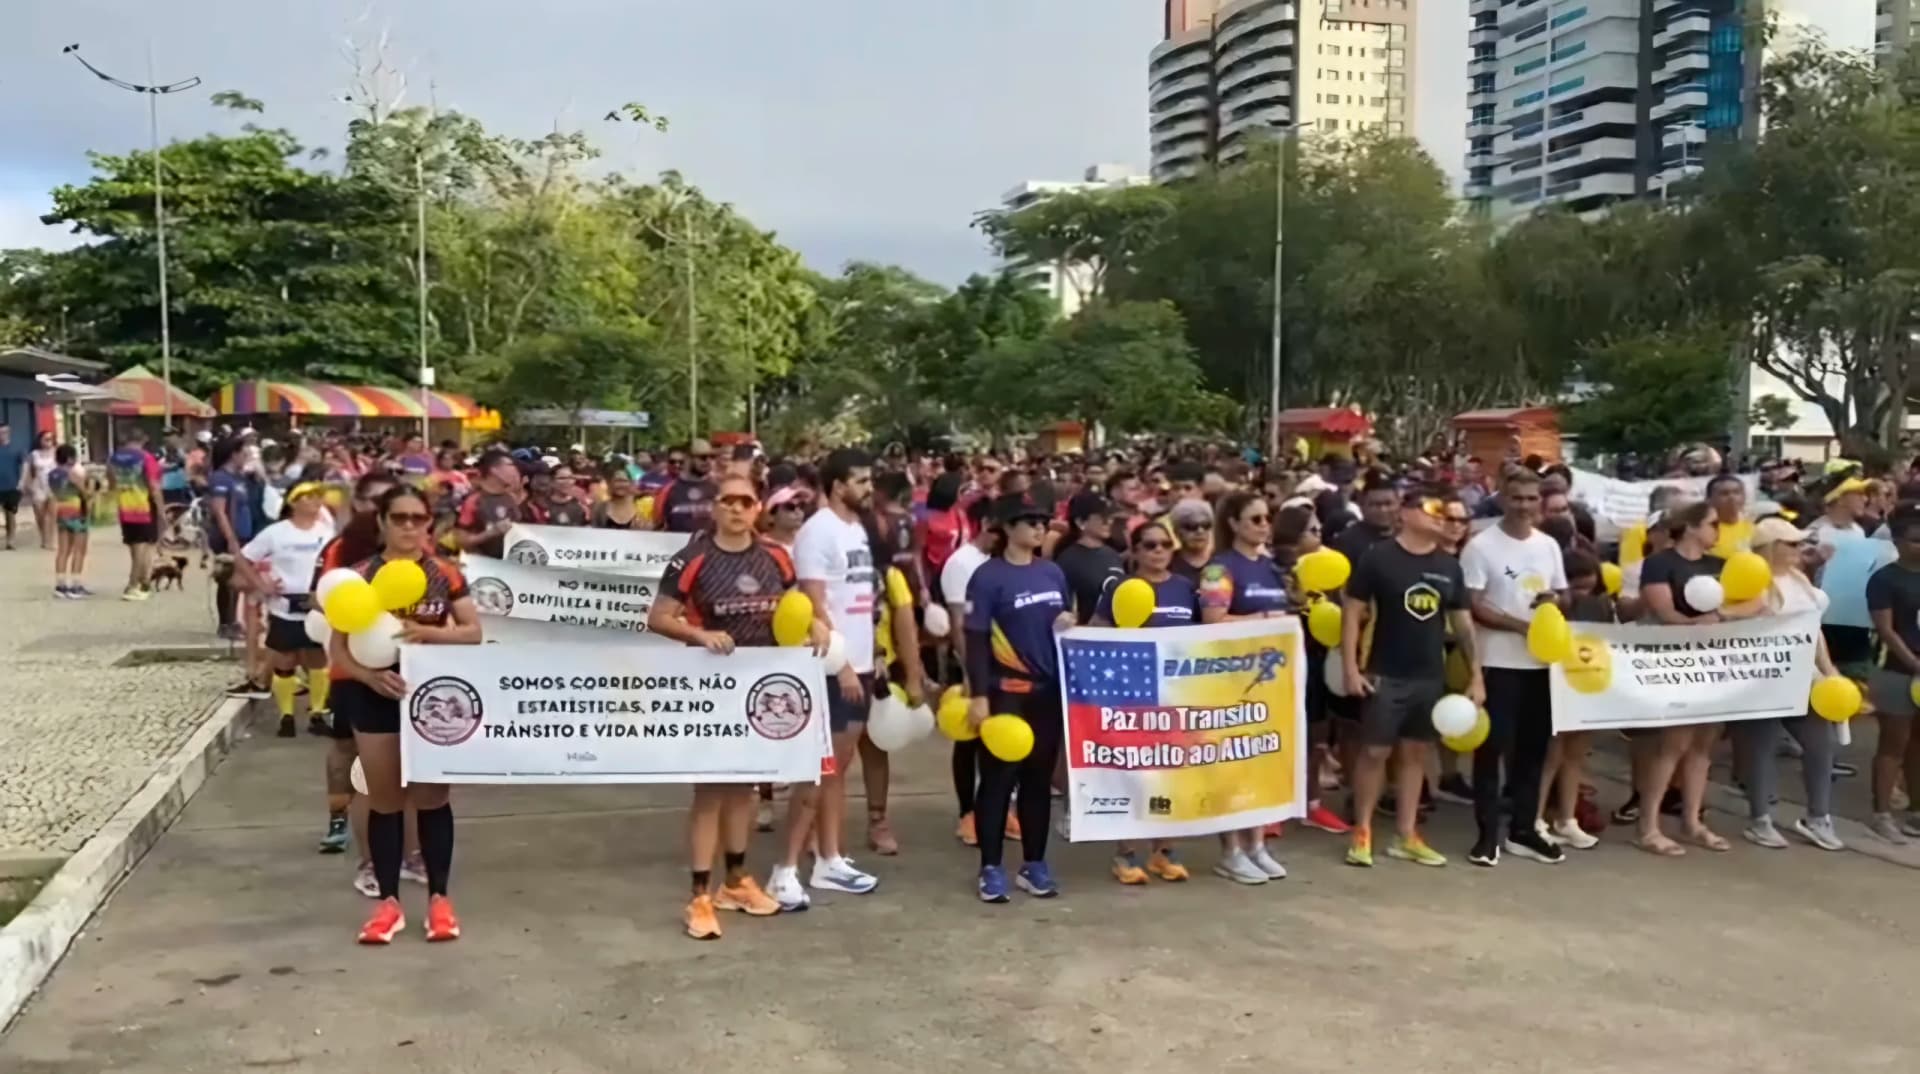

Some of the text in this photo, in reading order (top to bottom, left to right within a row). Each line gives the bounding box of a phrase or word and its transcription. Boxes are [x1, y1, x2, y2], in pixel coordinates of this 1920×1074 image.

[499, 673, 736, 692] SOMOS CORREDORES, NÃO
[517, 698, 714, 715] ESTATÍSTICAS, PAZ NO
[1101, 706, 1139, 731] Paz
[1143, 710, 1171, 731] no
[484, 720, 749, 738] TRÂNSITO E VIDA NAS PISTAS!
[1082, 739, 1185, 769] Respeito
[1189, 743, 1216, 765] ao
